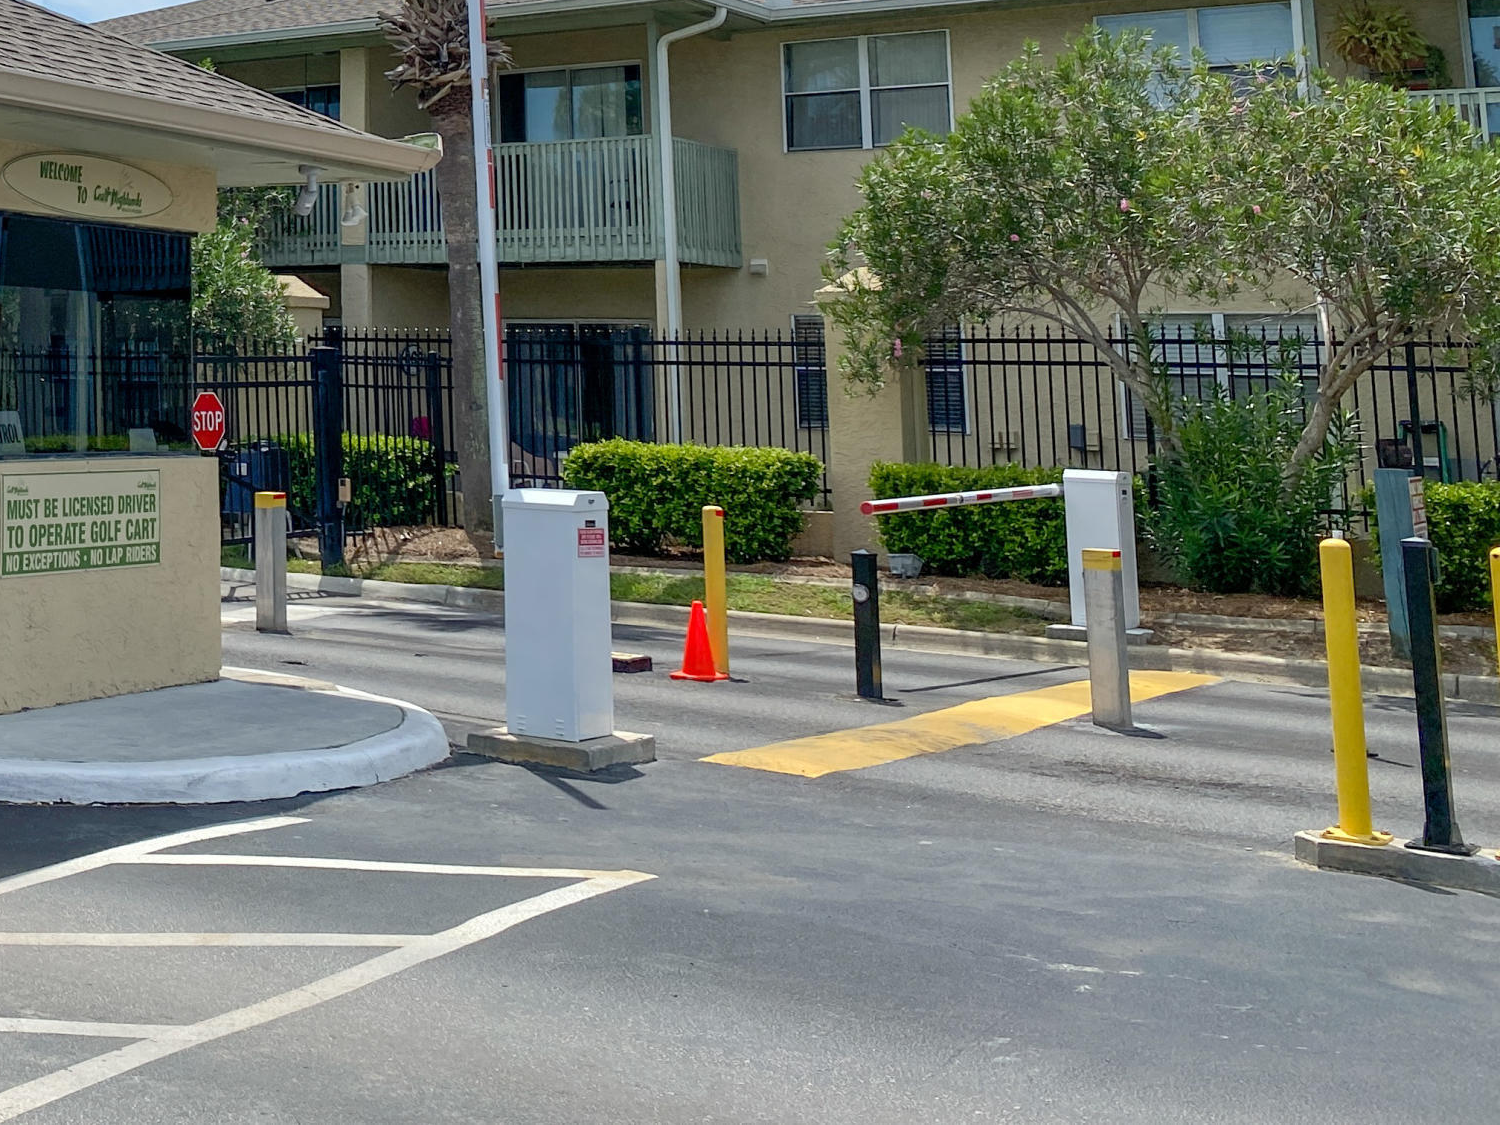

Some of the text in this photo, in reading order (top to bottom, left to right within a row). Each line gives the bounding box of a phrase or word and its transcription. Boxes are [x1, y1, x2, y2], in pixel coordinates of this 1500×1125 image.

[40, 161, 83, 183] WELCOME
[77, 186, 87, 204] TO
[193, 411, 223, 432] STOP
[7, 493, 156, 520] MUST BE LICENSED DRIVER
[7, 518, 156, 549] TO OPERATE GOLF CART
[6, 545, 157, 572] NO EXCEPTIONS NO LAP RIDERS
